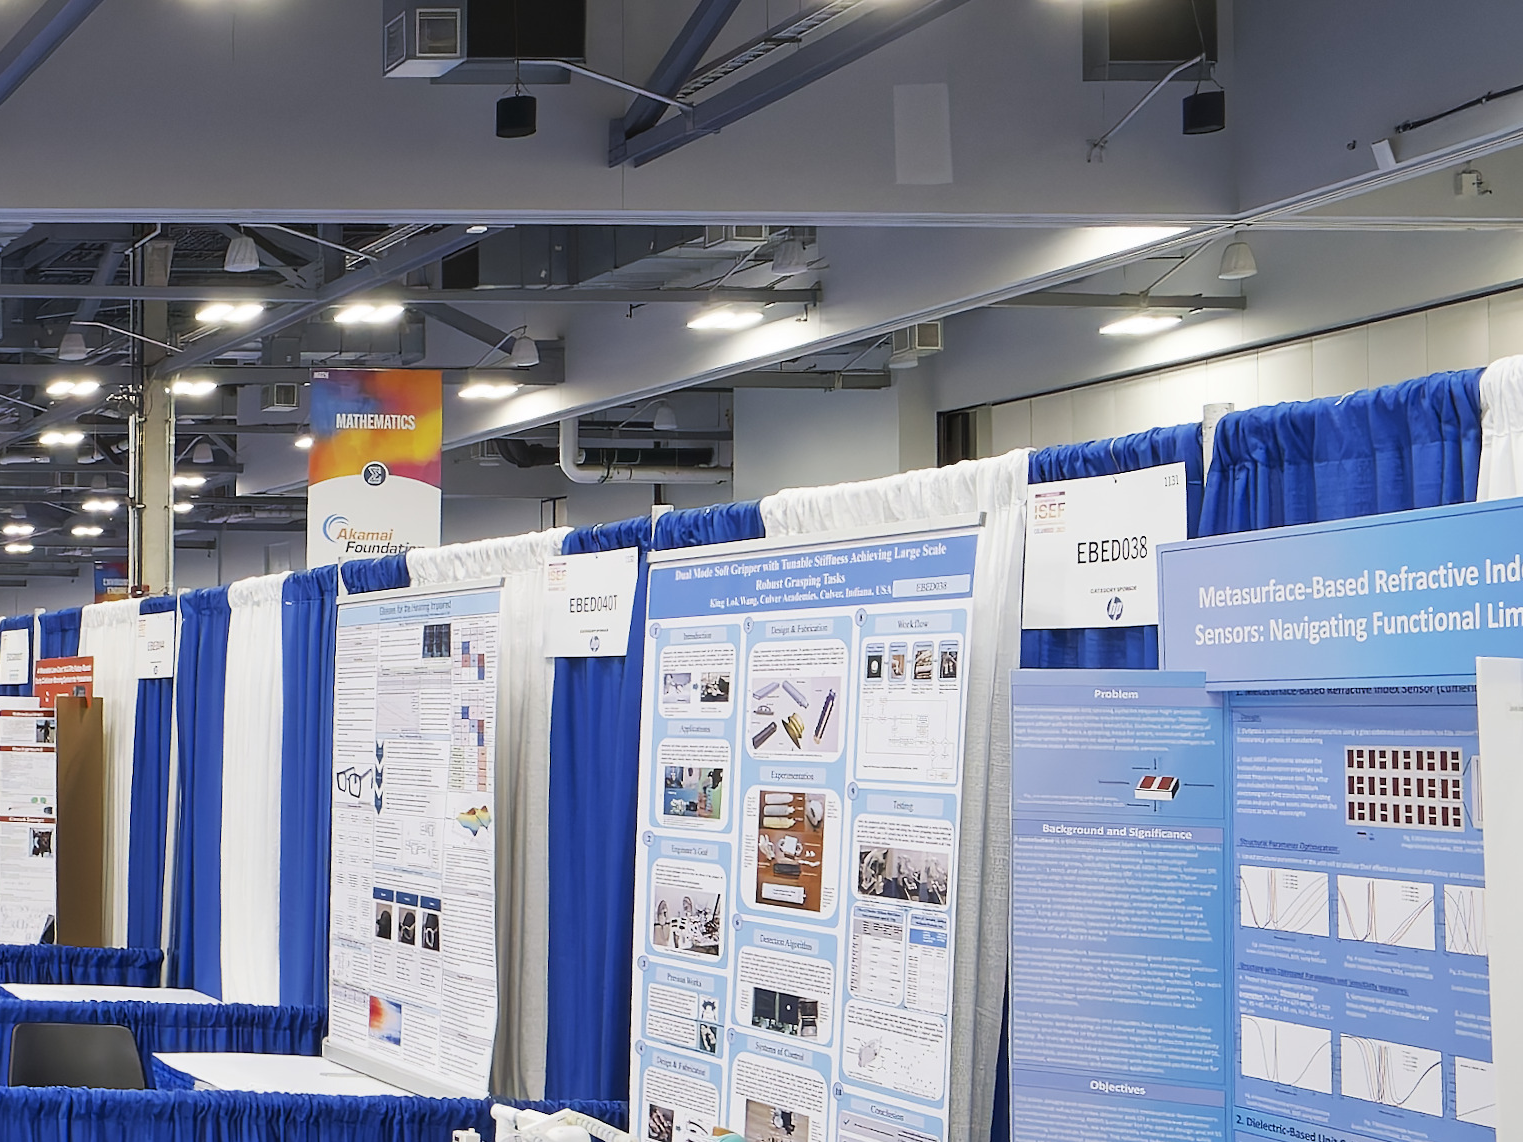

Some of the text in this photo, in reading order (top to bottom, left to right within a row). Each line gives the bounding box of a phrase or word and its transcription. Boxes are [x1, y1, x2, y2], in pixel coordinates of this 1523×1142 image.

[336, 413, 416, 431] MATHEMATICS
[1164, 475, 1179, 487] 1131
[1034, 502, 1066, 520] ISEF
[336, 528, 394, 541] Akamai
[1077, 535, 1148, 564] EBED038
[674, 542, 947, 581] Dual Mode Soft Gripper with Tunable Stiffness Achieving Large Scale
[755, 571, 846, 592] Robust Grasping Tasks
[1198, 553, 1523, 609] Metasurface-Based Refractive Ind
[759, 591, 782, 604] Culver
[819, 588, 844, 600] Culver,
[845, 585, 874, 599] Indiana,
[875, 584, 893, 596] USA
[569, 594, 617, 613] EBED040T
[1107, 596, 1123, 621] hp
[770, 624, 789, 636] Design
[796, 622, 828, 635] Fabrication
[897, 618, 929, 629] Workflow
[1195, 624, 1264, 646] Sensors:
[1269, 613, 1368, 644] Navigating
[1373, 602, 1481, 635] Functional
[1094, 689, 1139, 700] Problem
[770, 769, 815, 782] Experimentation
[892, 801, 914, 813] Testing
[1042, 823, 1193, 840] Background and Significance
[760, 933, 783, 947] Detection
[754, 1041, 805, 1061] Systems of Control
[1089, 1079, 1146, 1096] Objectives
[870, 1104, 905, 1121] Conclusion
[1236, 1114, 1244, 1124] 2.
[1246, 1115, 1316, 1142] Dielectric-Based
